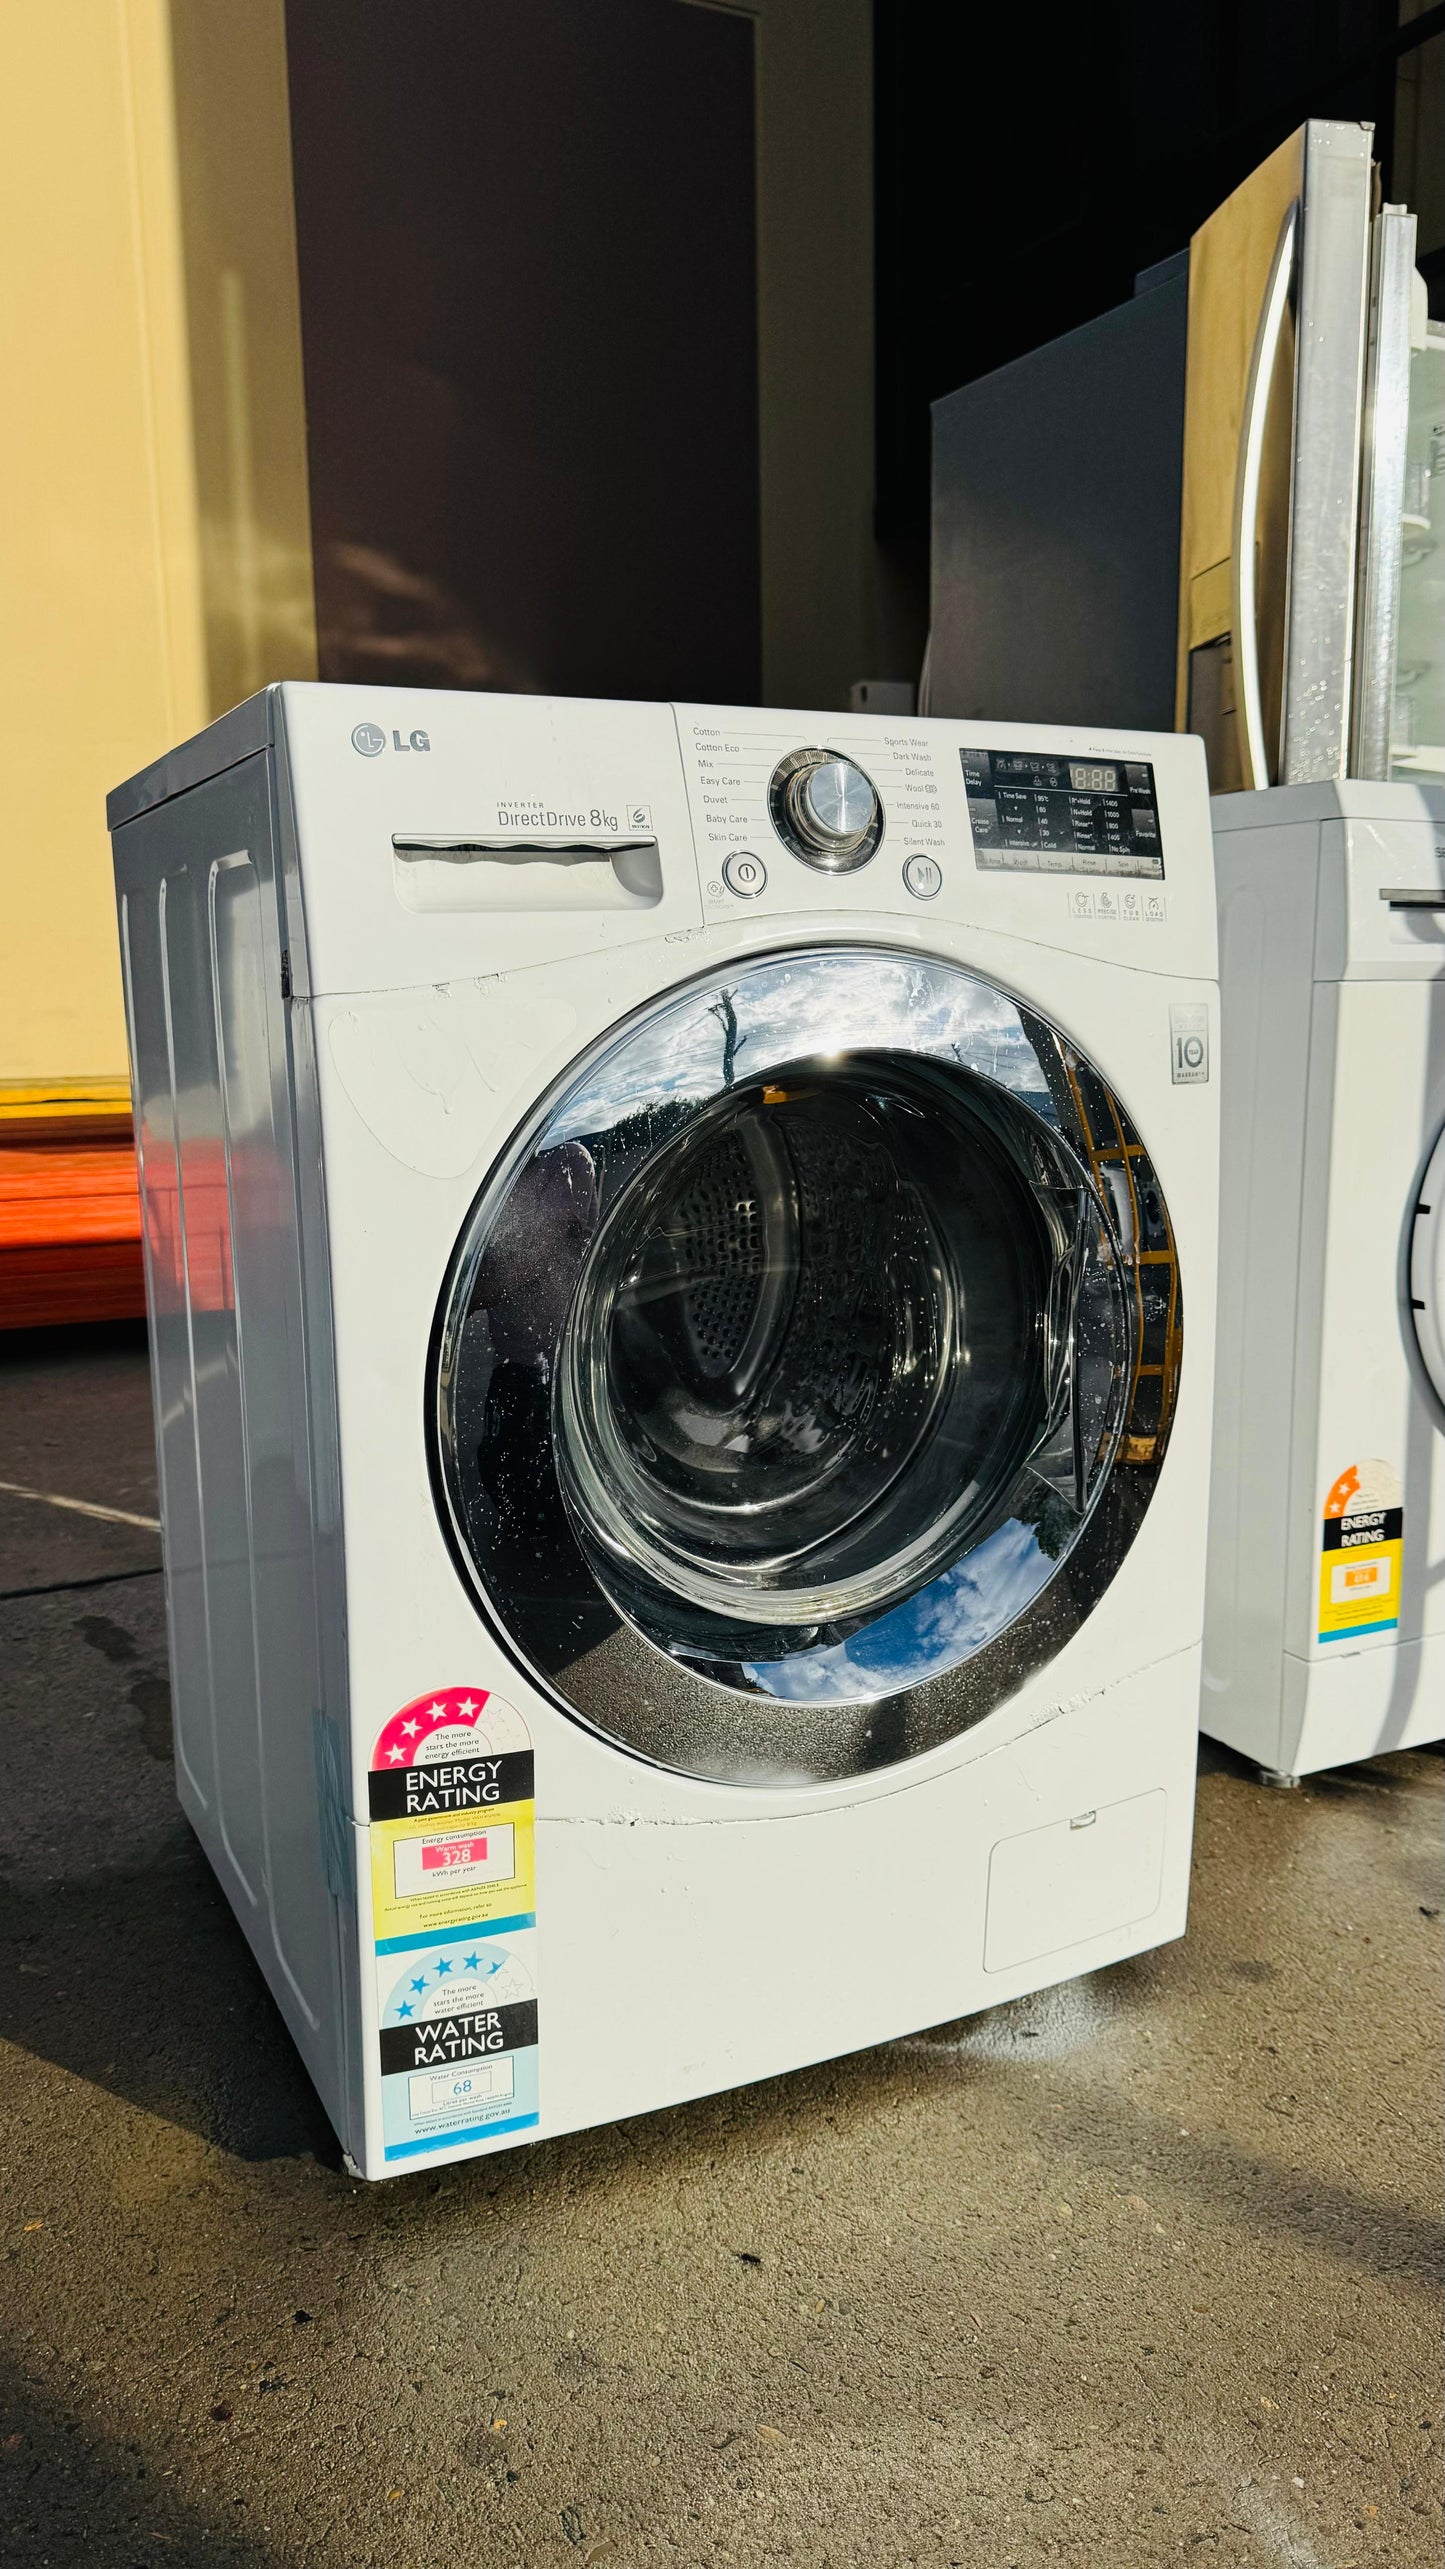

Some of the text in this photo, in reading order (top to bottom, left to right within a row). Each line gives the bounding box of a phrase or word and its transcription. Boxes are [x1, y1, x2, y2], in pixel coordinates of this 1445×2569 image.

[693, 727, 720, 736] Cotton
[393, 730, 431, 751] LG
[884, 737, 908, 747] Sports
[696, 743, 739, 752] Cotton Eco
[893, 752, 931, 761] Dark Wash
[906, 768, 934, 776] Delicate
[701, 776, 740, 786] Easy Care
[905, 784, 924, 792] Wool
[704, 795, 728, 803] Duvet
[897, 802, 929, 810] Intensive
[590, 809, 618, 832] 8kg
[706, 814, 748, 824] Baby Care
[912, 820, 932, 828] Quick
[709, 833, 747, 841] Skin Care
[904, 837, 945, 846] Silent Wash
[1176, 1036, 1204, 1068] 10
[1341, 1512, 1386, 1531] ENERGY
[1341, 1529, 1385, 1547] RATING
[452, 1748, 479, 1756] efficient
[406, 1760, 502, 1791] ENERGY
[406, 1783, 500, 1813] RATING
[422, 1830, 487, 1844] Energy consumption
[436, 1843, 457, 1852] Warm
[443, 1849, 471, 1866] 328
[433, 1869, 448, 1877] kWh
[463, 1866, 476, 1874] year
[435, 2001, 483, 2014] water efficient
[416, 2012, 501, 2043] WATER
[415, 2032, 503, 2066] RATING
[430, 2065, 493, 2081] Water Consumption
[454, 2080, 471, 2095] 68
[415, 2109, 510, 2134] www.waterrating.gov.au
